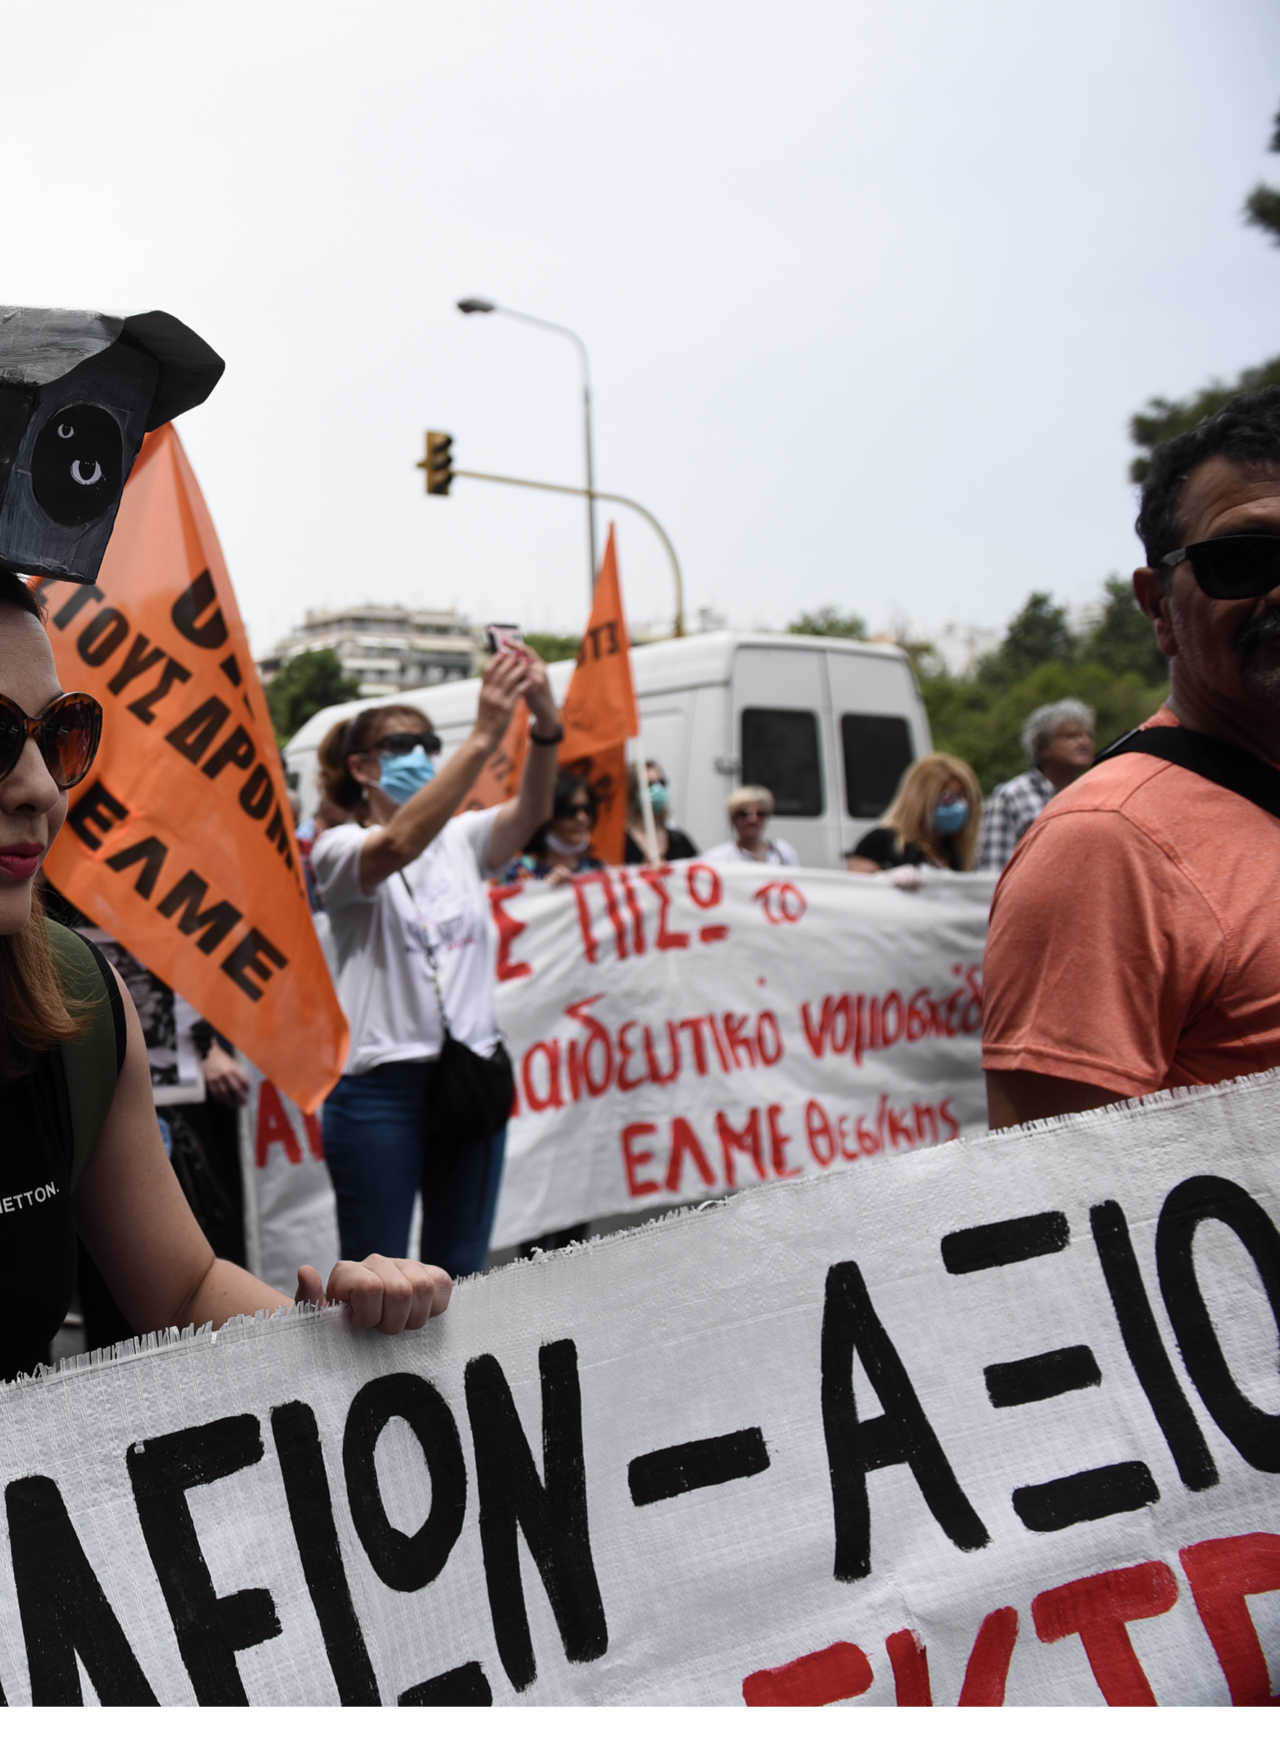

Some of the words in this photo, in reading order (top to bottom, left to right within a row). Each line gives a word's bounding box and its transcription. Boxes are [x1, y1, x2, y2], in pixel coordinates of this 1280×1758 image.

[68, 778, 289, 1003] ΕΛΜΕ
[510, 976, 784, 1118] αιδευτικό
[621, 1103, 803, 1197] ΕΛΜΕ
